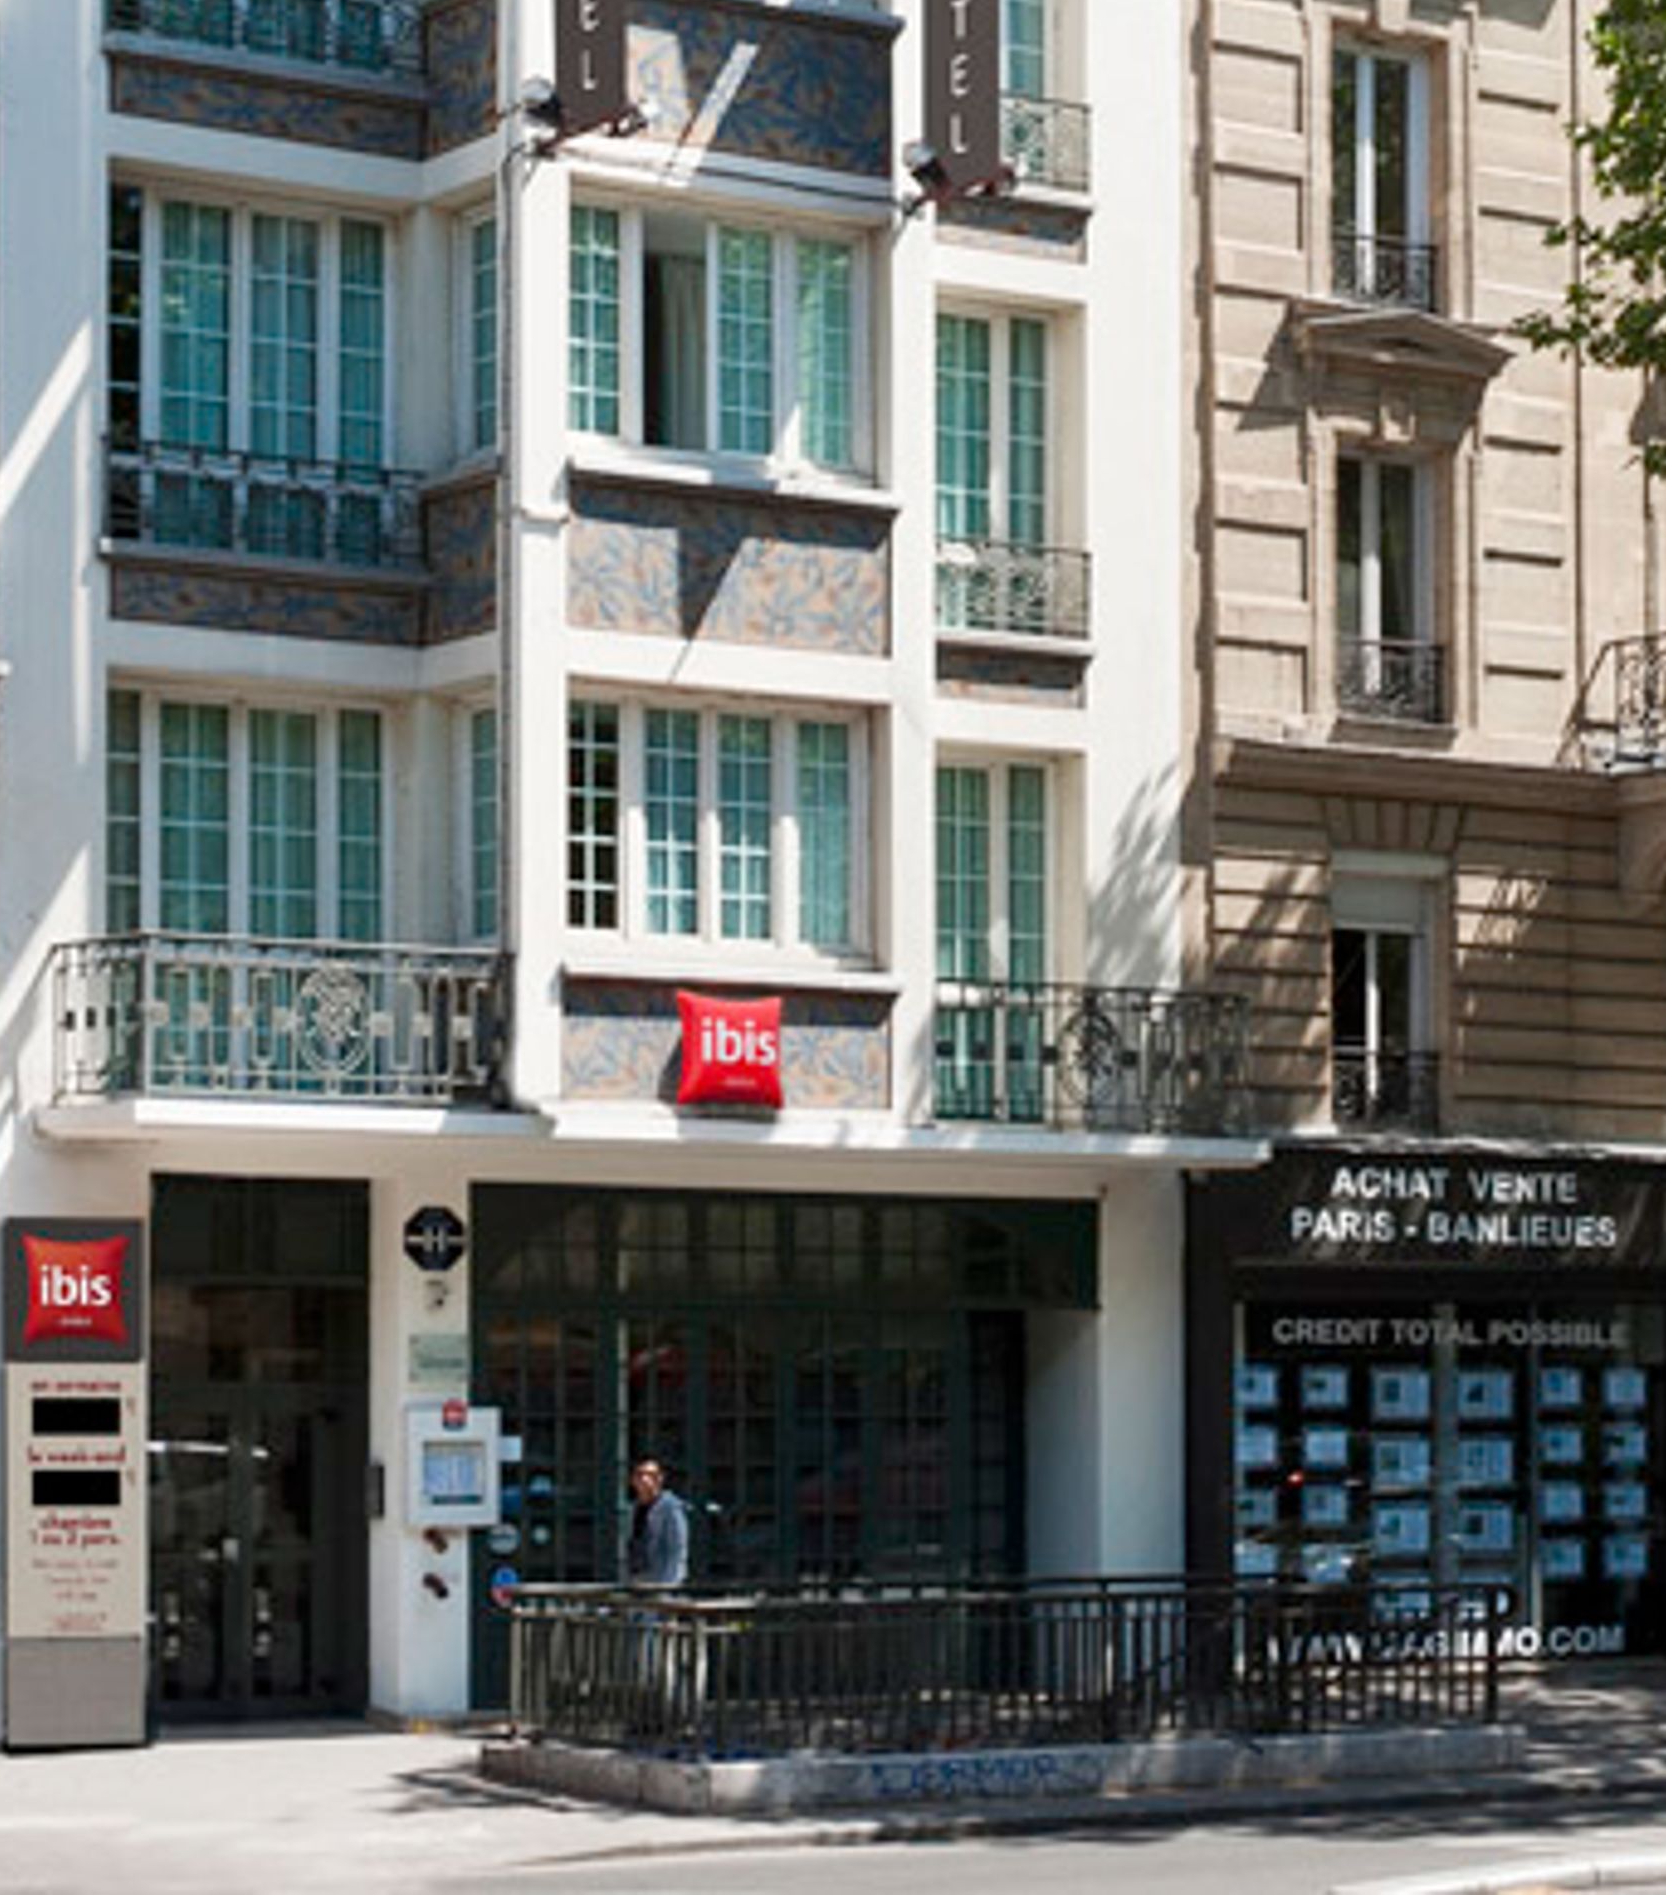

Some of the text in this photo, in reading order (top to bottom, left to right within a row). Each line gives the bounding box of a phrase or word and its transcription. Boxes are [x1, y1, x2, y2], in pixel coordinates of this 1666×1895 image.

[700, 1017, 778, 1066] ibis
[1331, 1167, 1579, 1204] ACHAT VENTE
[1290, 1209, 1397, 1243] PARIS
[1428, 1213, 1617, 1247] BANLIEUES
[40, 1265, 113, 1309] ibis
[1272, 1318, 1630, 1347] CREDIT TOTAL POSSIBLE
